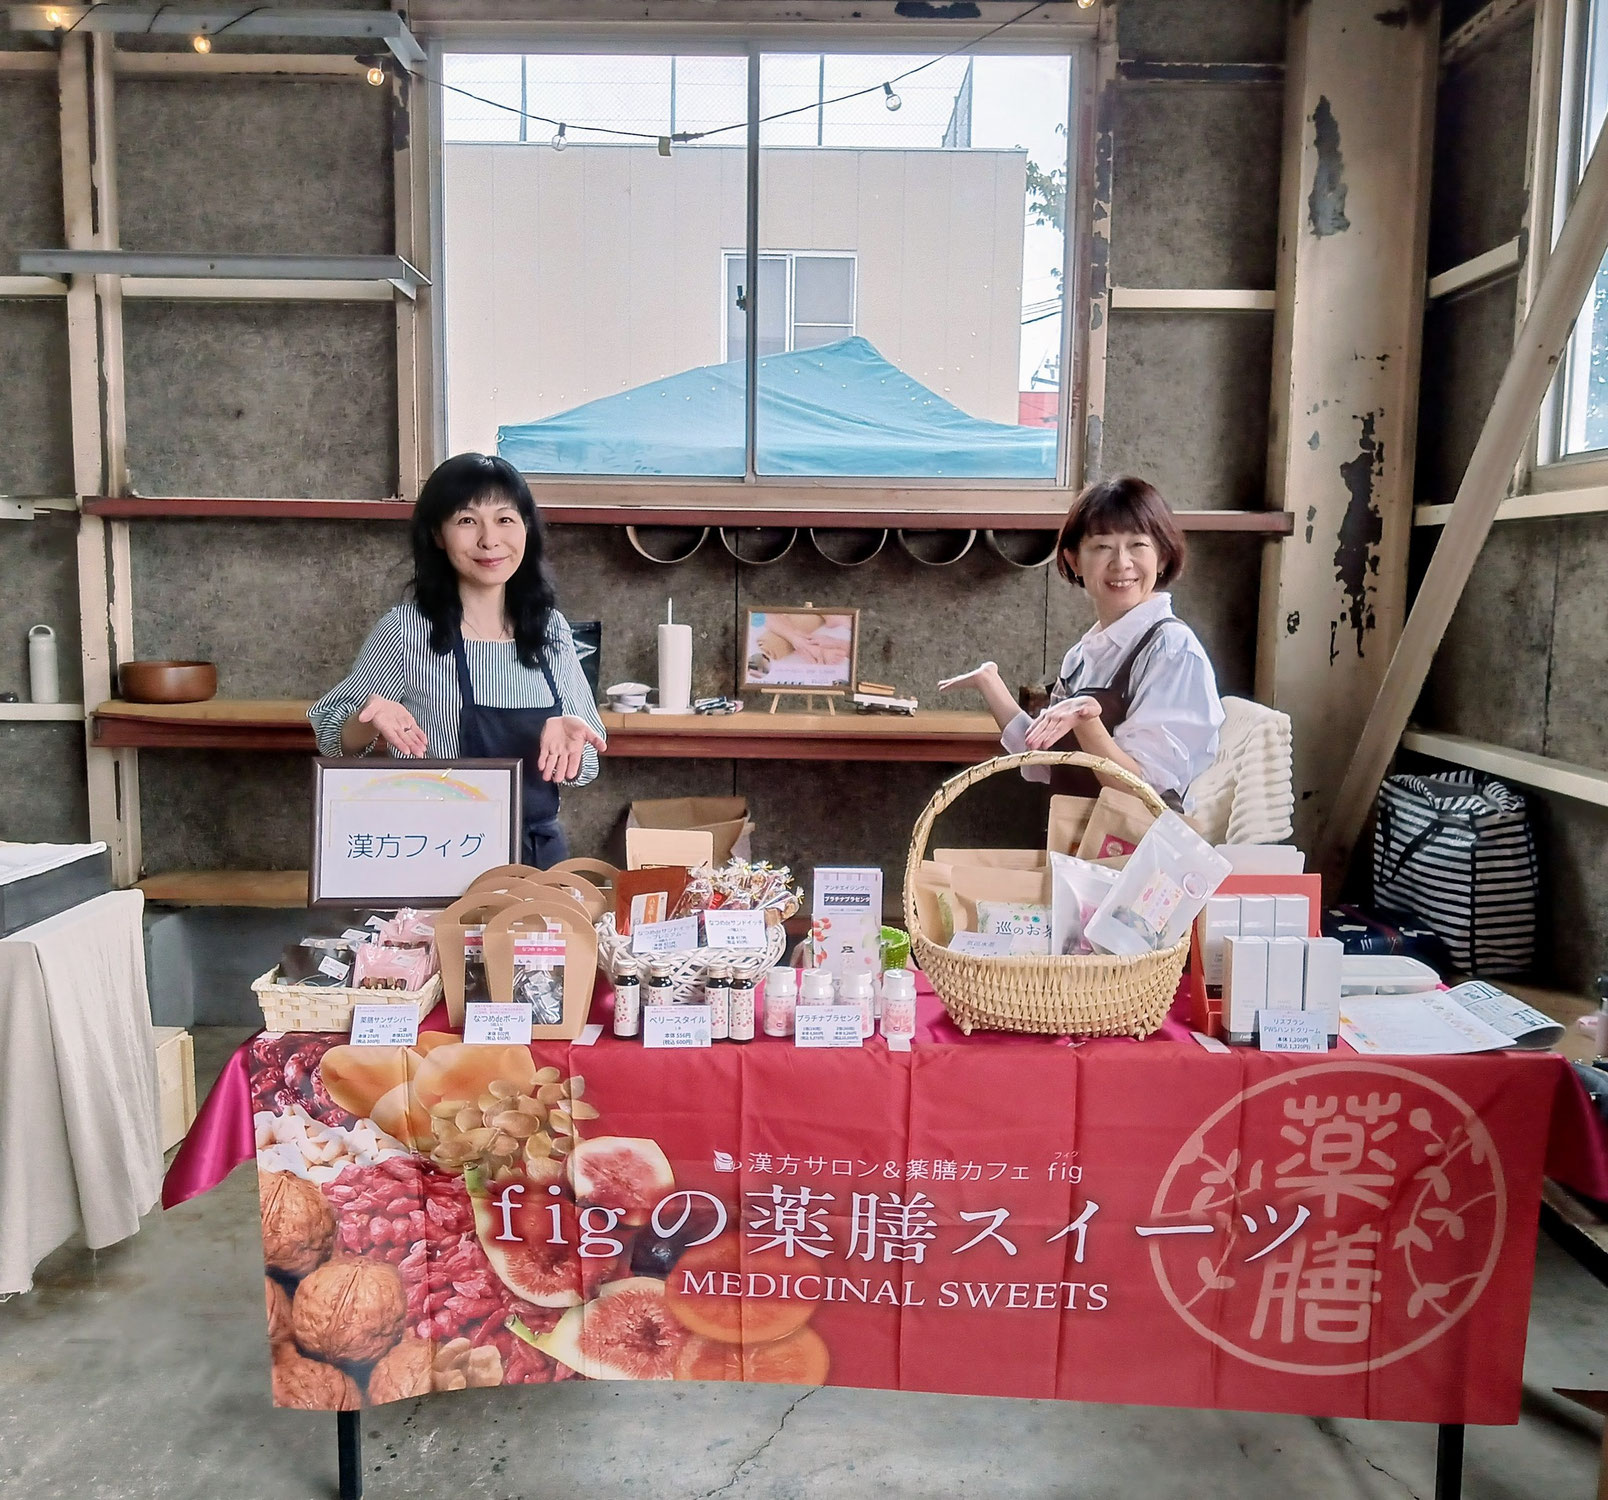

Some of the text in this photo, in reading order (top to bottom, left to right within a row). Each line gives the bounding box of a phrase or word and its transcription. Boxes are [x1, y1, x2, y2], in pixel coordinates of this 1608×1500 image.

[347, 833, 486, 859] 漢方フィグ
[360, 1016, 413, 1024] 薬膳サンザシバー
[474, 1015, 526, 1023] なつめdeボール
[650, 1016, 706, 1024] ベリースタイル
[797, 1014, 861, 1022] プラチナプラセンタ
[748, 1152, 1083, 1184] 漢方サロン&薬膳カフェ fig
[492, 1184, 1311, 1263] figの薬膳スイーツ
[680, 1270, 1109, 1311] MEDICINAL SWEETS
